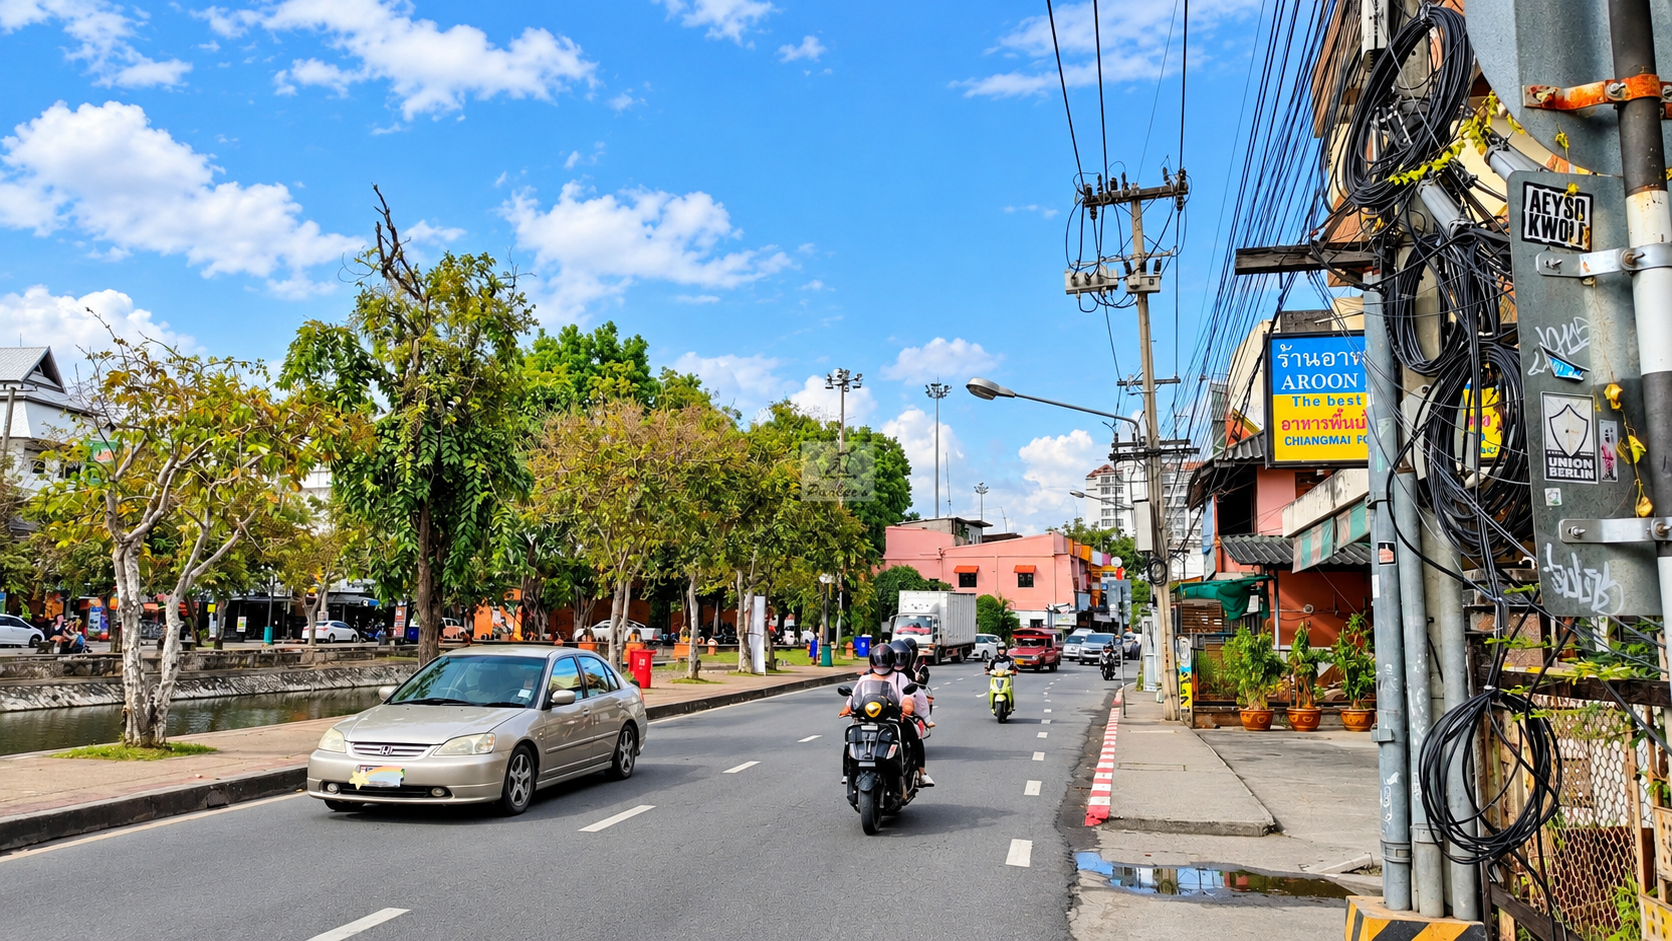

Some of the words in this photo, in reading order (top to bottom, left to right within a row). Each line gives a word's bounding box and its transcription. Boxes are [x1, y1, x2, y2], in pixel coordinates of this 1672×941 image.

[1281, 372, 1359, 390] AROON
[1291, 395, 1321, 407] The
[1327, 394, 1362, 407] best
[1284, 435, 1351, 446] CHIANGMAI
[1548, 456, 1594, 469] UNION
[1548, 466, 1595, 480] BERLIN
